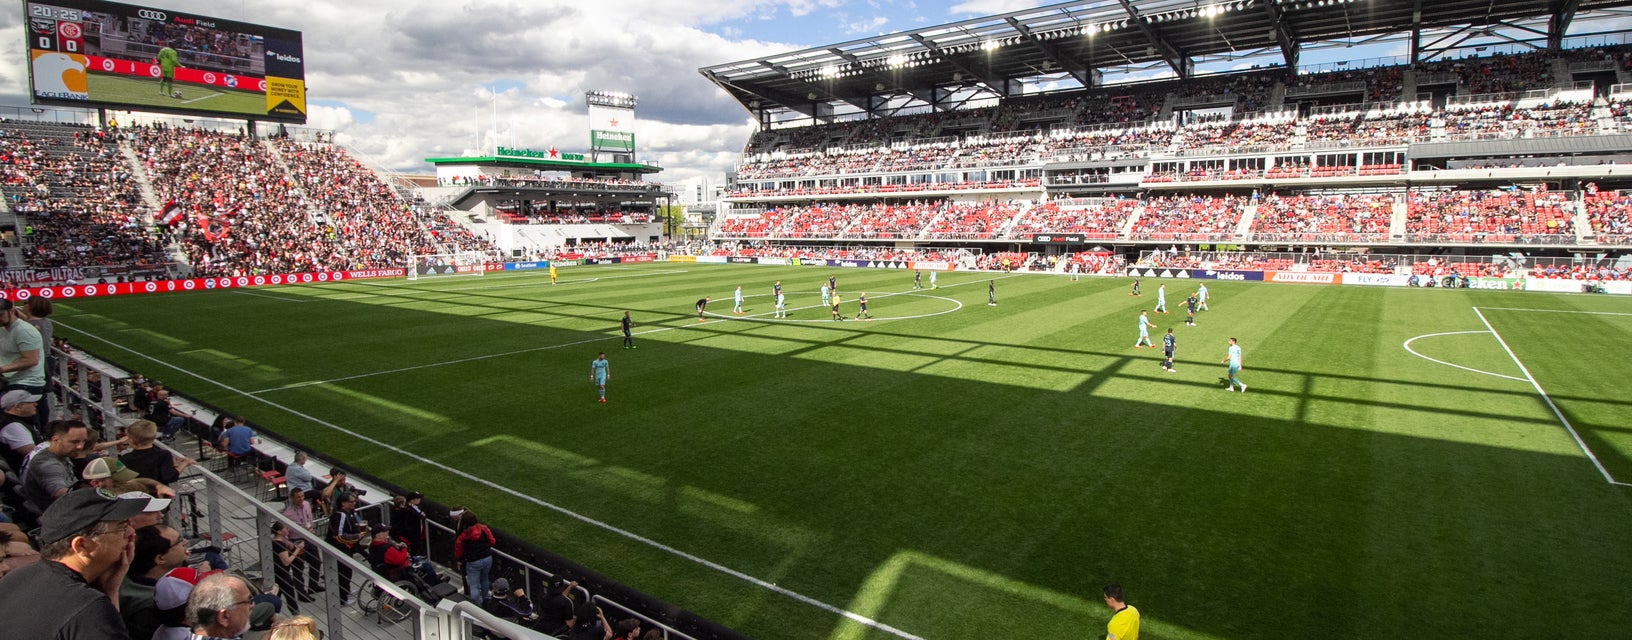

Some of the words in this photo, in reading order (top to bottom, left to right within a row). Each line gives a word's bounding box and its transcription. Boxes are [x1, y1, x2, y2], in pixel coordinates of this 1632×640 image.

[33, 6, 78, 20] 20:25
[174, 16, 195, 25] Audi
[196, 20, 216, 28] Field
[39, 36, 50, 49] 0
[66, 39, 77, 52] 0
[276, 53, 302, 63] leidos
[596, 131, 632, 142] Heineken
[497, 146, 544, 158] Heineken
[0, 269, 35, 282] ISTRICT
[51, 268, 83, 280] ULTRAS
[350, 270, 376, 278] WELLS
[378, 268, 403, 277] FARGO
[1217, 271, 1245, 280] leidos
[1359, 275, 1372, 283] FLY
